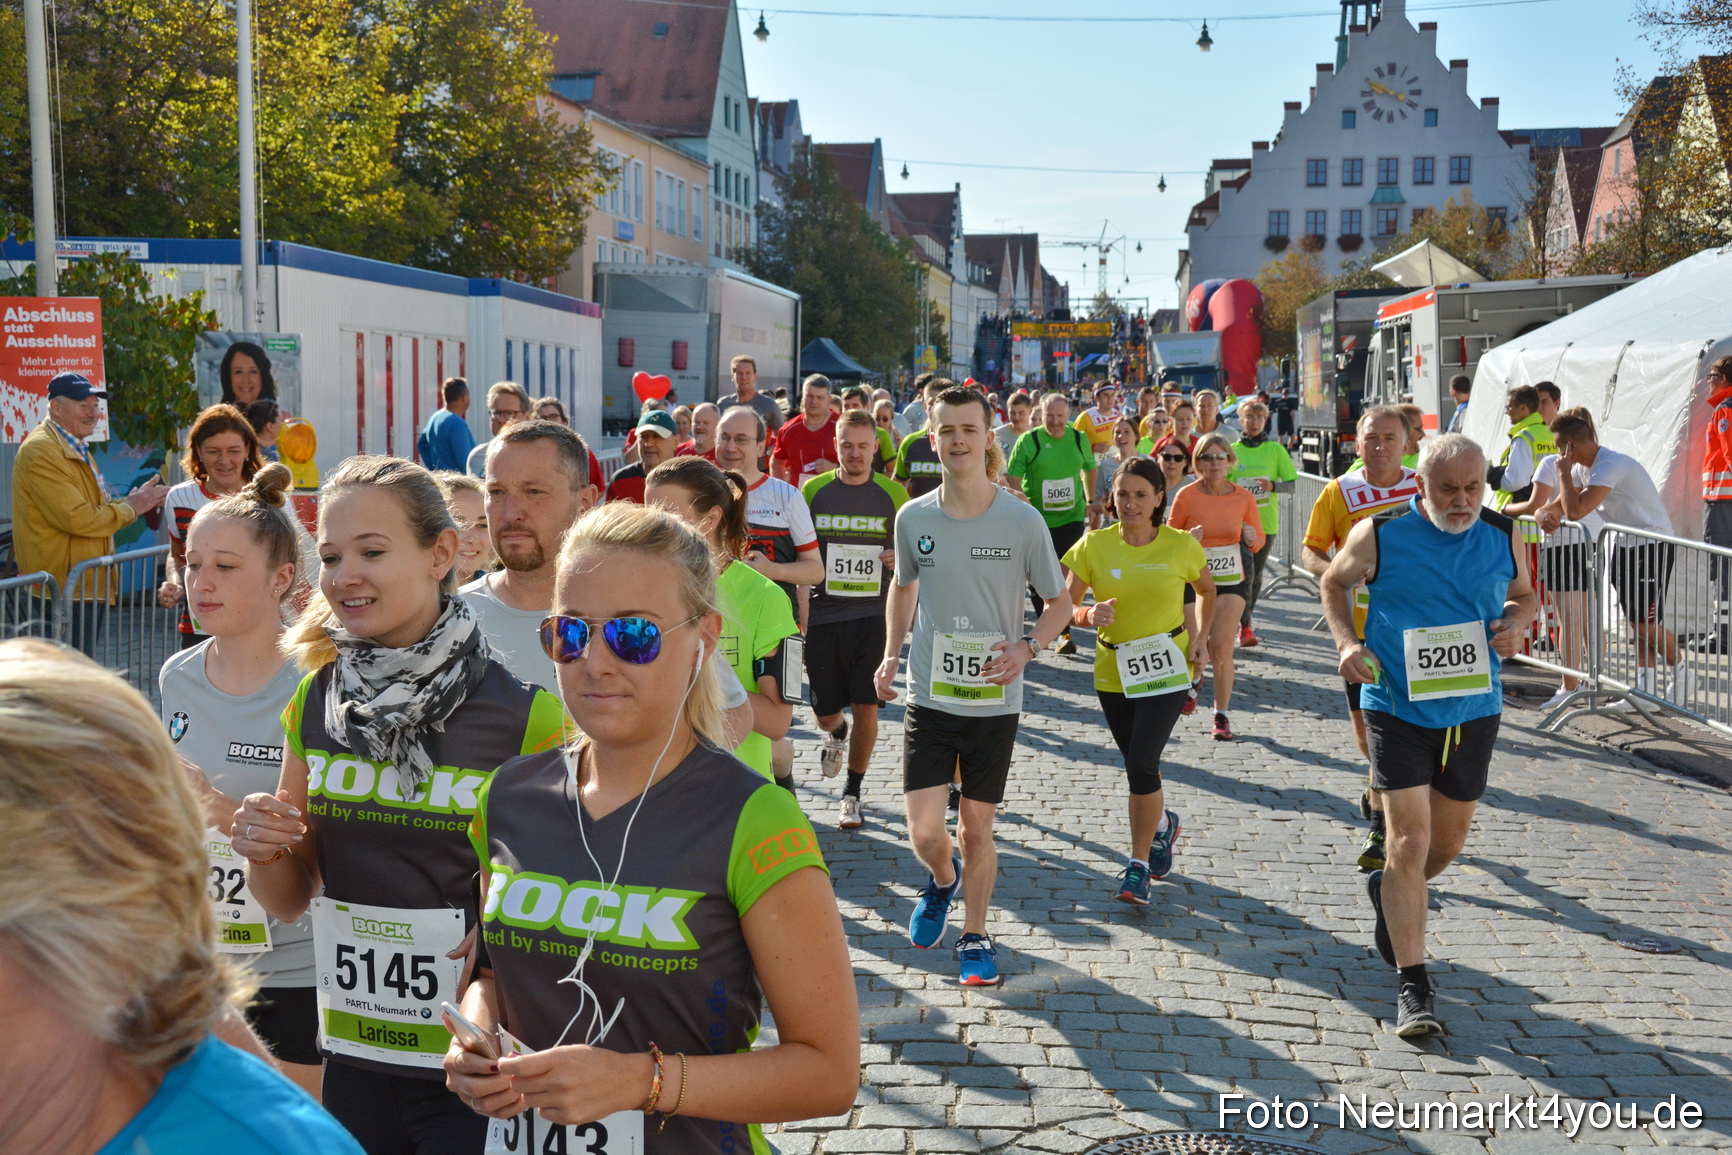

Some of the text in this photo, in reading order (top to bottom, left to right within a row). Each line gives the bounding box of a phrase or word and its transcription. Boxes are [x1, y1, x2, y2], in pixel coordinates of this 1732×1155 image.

[4, 307, 94, 323] Abschluss
[4, 323, 34, 333] statt
[1045, 324, 1078, 334] START
[5, 334, 96, 348] Ausschluss!
[22, 356, 93, 366] Mehr Lehrer für
[18, 367, 56, 377] kleinere
[1047, 487, 1071, 499] 5062
[815, 514, 887, 533] BOCK
[971, 547, 1011, 557] BOCK
[835, 558, 874, 575] 5148
[1206, 556, 1235, 571] 5224
[843, 583, 864, 591] Marco
[953, 616, 974, 629] 19.
[1428, 631, 1463, 642] BOCK
[953, 641, 984, 651] BOCK
[1127, 649, 1173, 676] 5151
[1418, 643, 1477, 670] 5208
[954, 687, 981, 699] Marije
[1147, 681, 1167, 690] Hilde
[228, 742, 283, 762] BOCK
[306, 752, 488, 812] BOCK
[332, 803, 352, 821] by
[357, 809, 407, 826] smart
[413, 816, 472, 832] conce
[483, 866, 704, 949] BOCK
[352, 916, 413, 940] BOCK
[511, 930, 533, 953] by
[540, 940, 595, 961] smat
[601, 951, 698, 975] concepts
[336, 943, 439, 1001] 5145
[345, 998, 417, 1017] PARTL Neumarkt
[358, 1020, 419, 1047] Larissa
